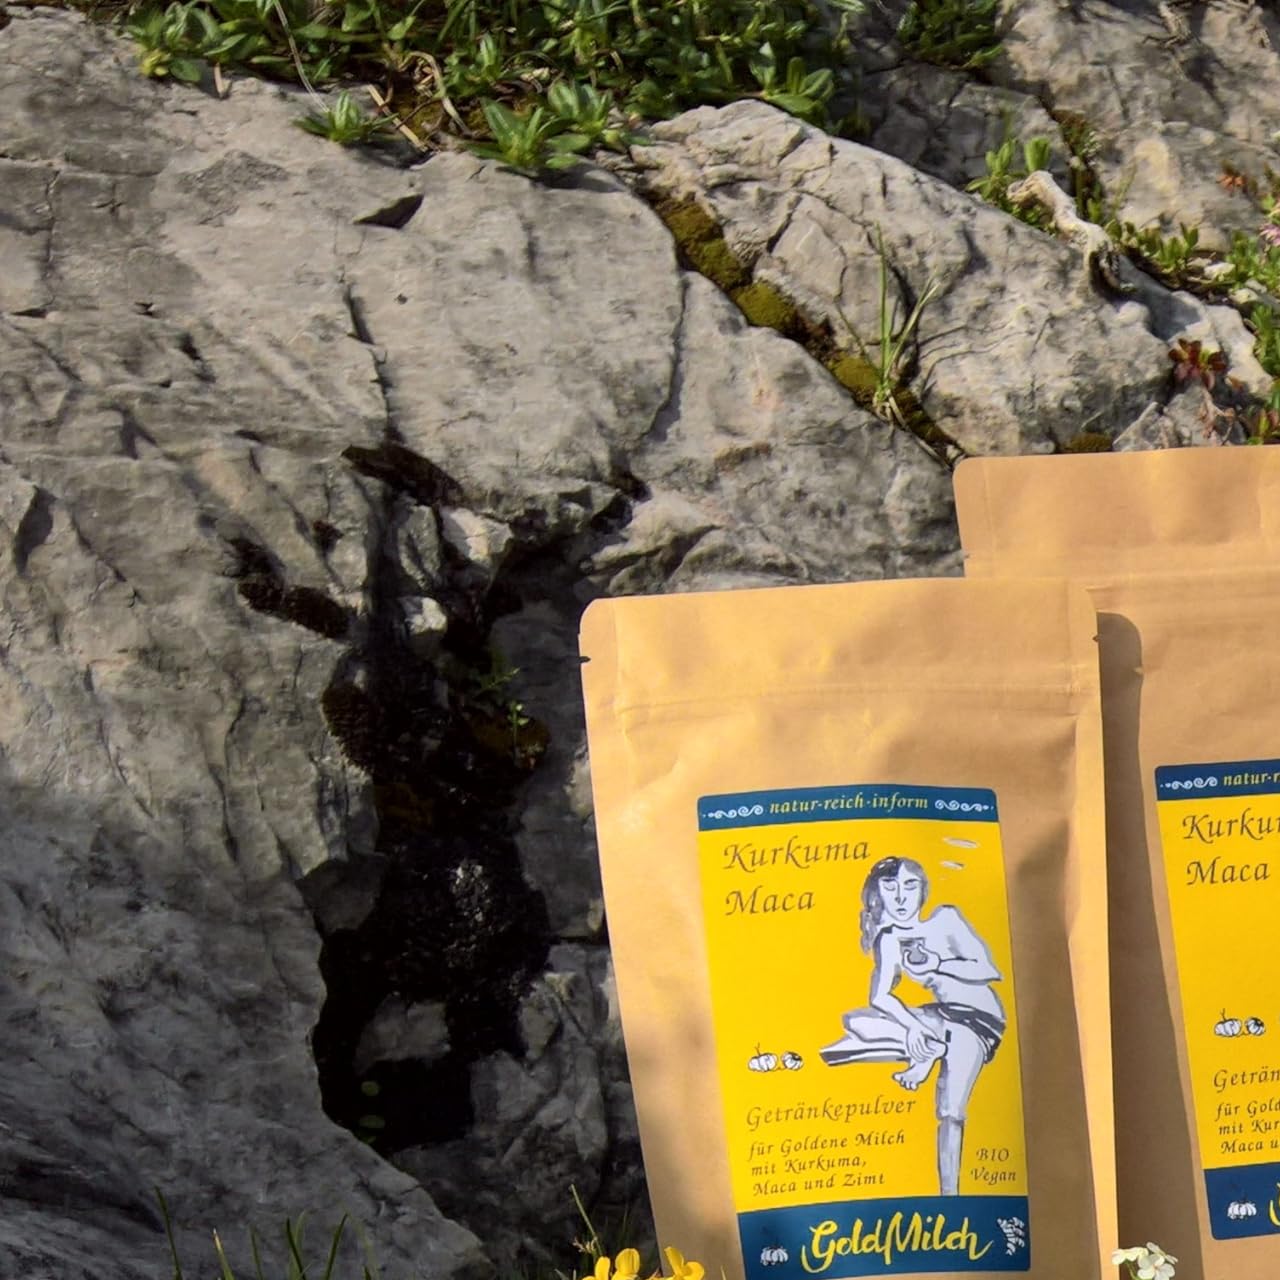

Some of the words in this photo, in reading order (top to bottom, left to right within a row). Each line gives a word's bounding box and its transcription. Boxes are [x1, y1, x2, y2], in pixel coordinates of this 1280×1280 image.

[723, 835, 871, 873] Kurkuma
[1186, 857, 1270, 885] Maca
[725, 885, 815, 916] Maca
[746, 1094, 916, 1131] Getränkepulver
[1215, 1103, 1240, 1121] für
[1219, 1121, 1244, 1136] mit
[749, 1142, 775, 1161] für
[781, 1136, 848, 1157] Goldene
[855, 1130, 905, 1147] Milch
[976, 1147, 1010, 1161] BIO
[1221, 1138, 1264, 1154] Maca
[751, 1160, 777, 1177] mit
[785, 1154, 867, 1174] Kurkuma,
[970, 1167, 1017, 1185] Vegan
[752, 1182, 797, 1197] Maca
[804, 1176, 835, 1190] und
[842, 1172, 885, 1187] Zimt
[801, 1211, 994, 1274] GoldMilch
